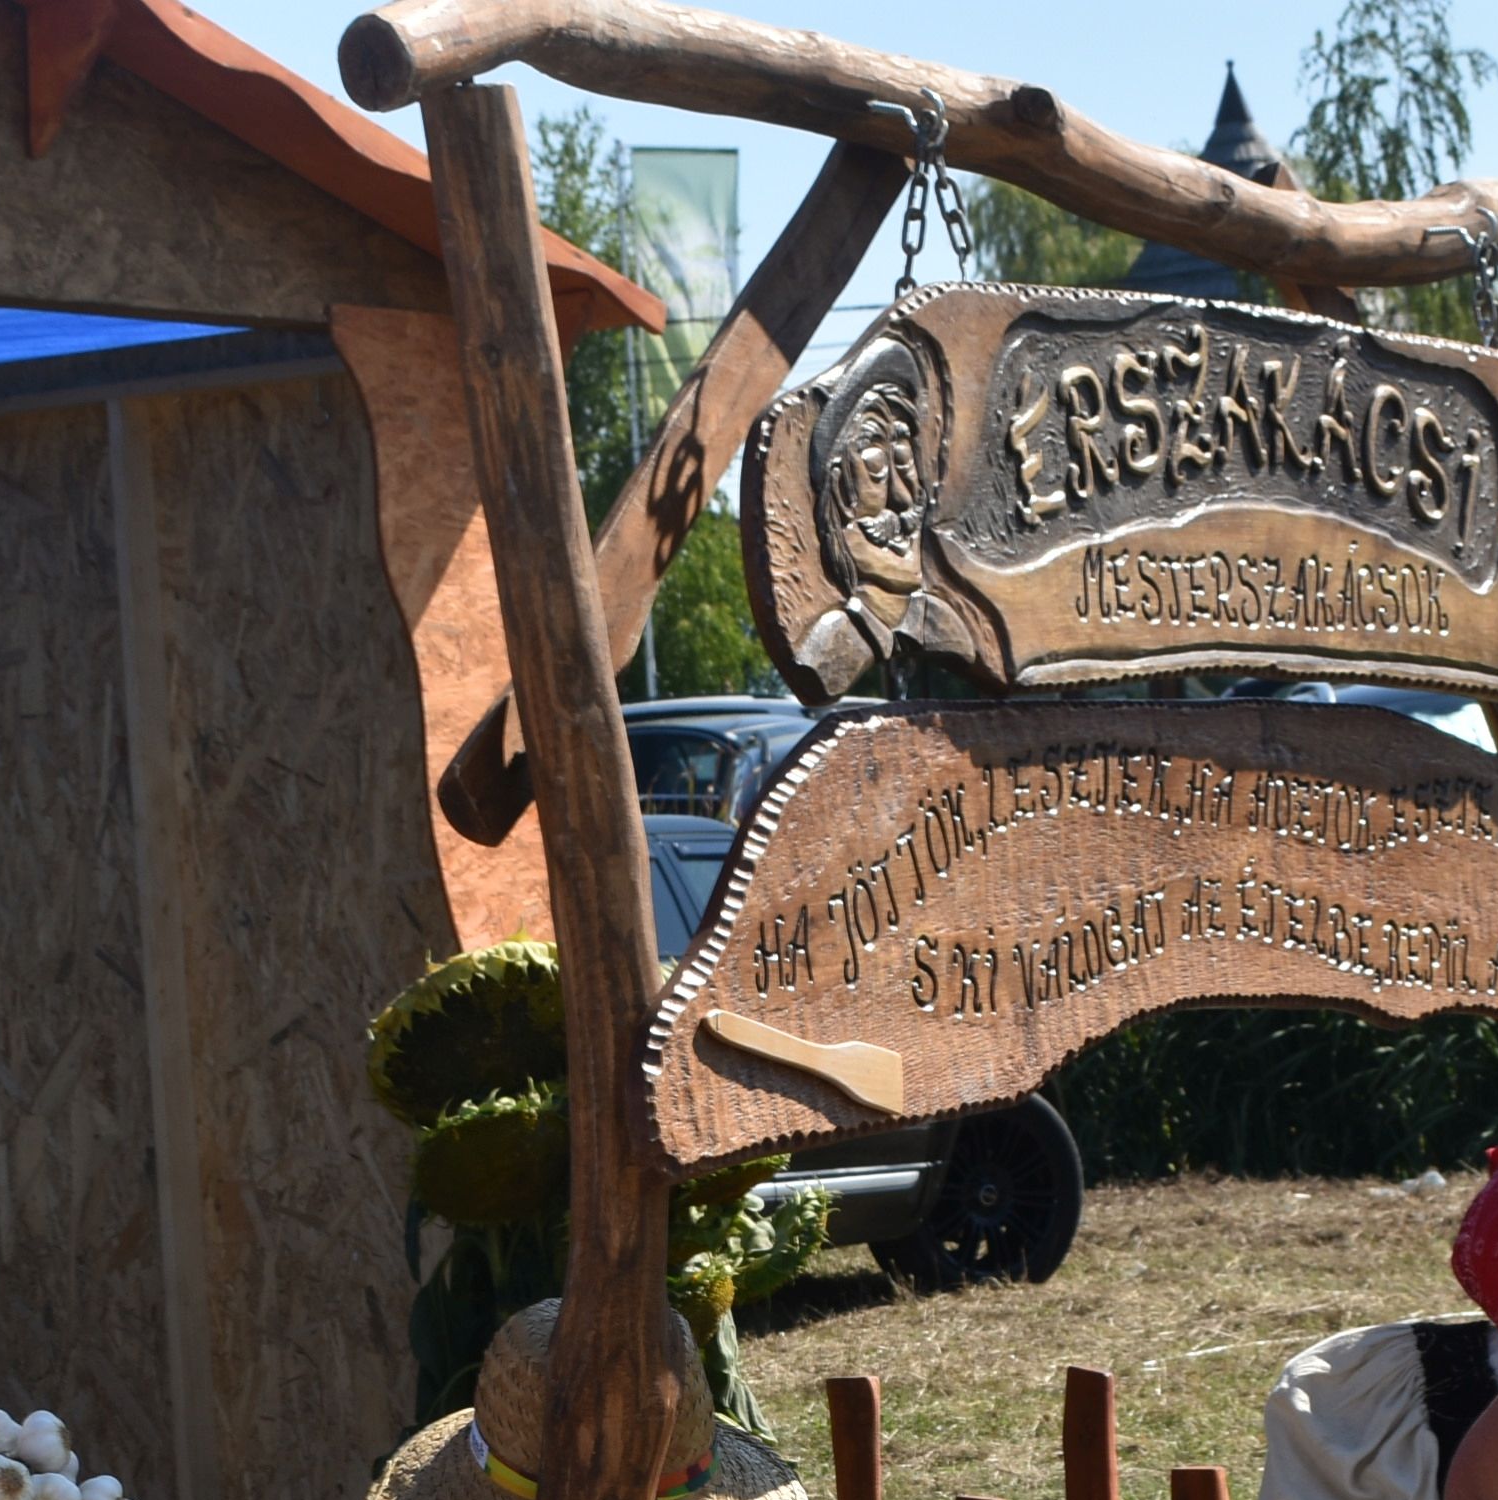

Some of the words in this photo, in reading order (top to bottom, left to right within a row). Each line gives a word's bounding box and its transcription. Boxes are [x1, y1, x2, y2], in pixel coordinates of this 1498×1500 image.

[1075, 540, 1450, 637] MESTERSZAKÁCSOK
[754, 904, 815, 998] HA
[1179, 872, 1226, 942] AZ
